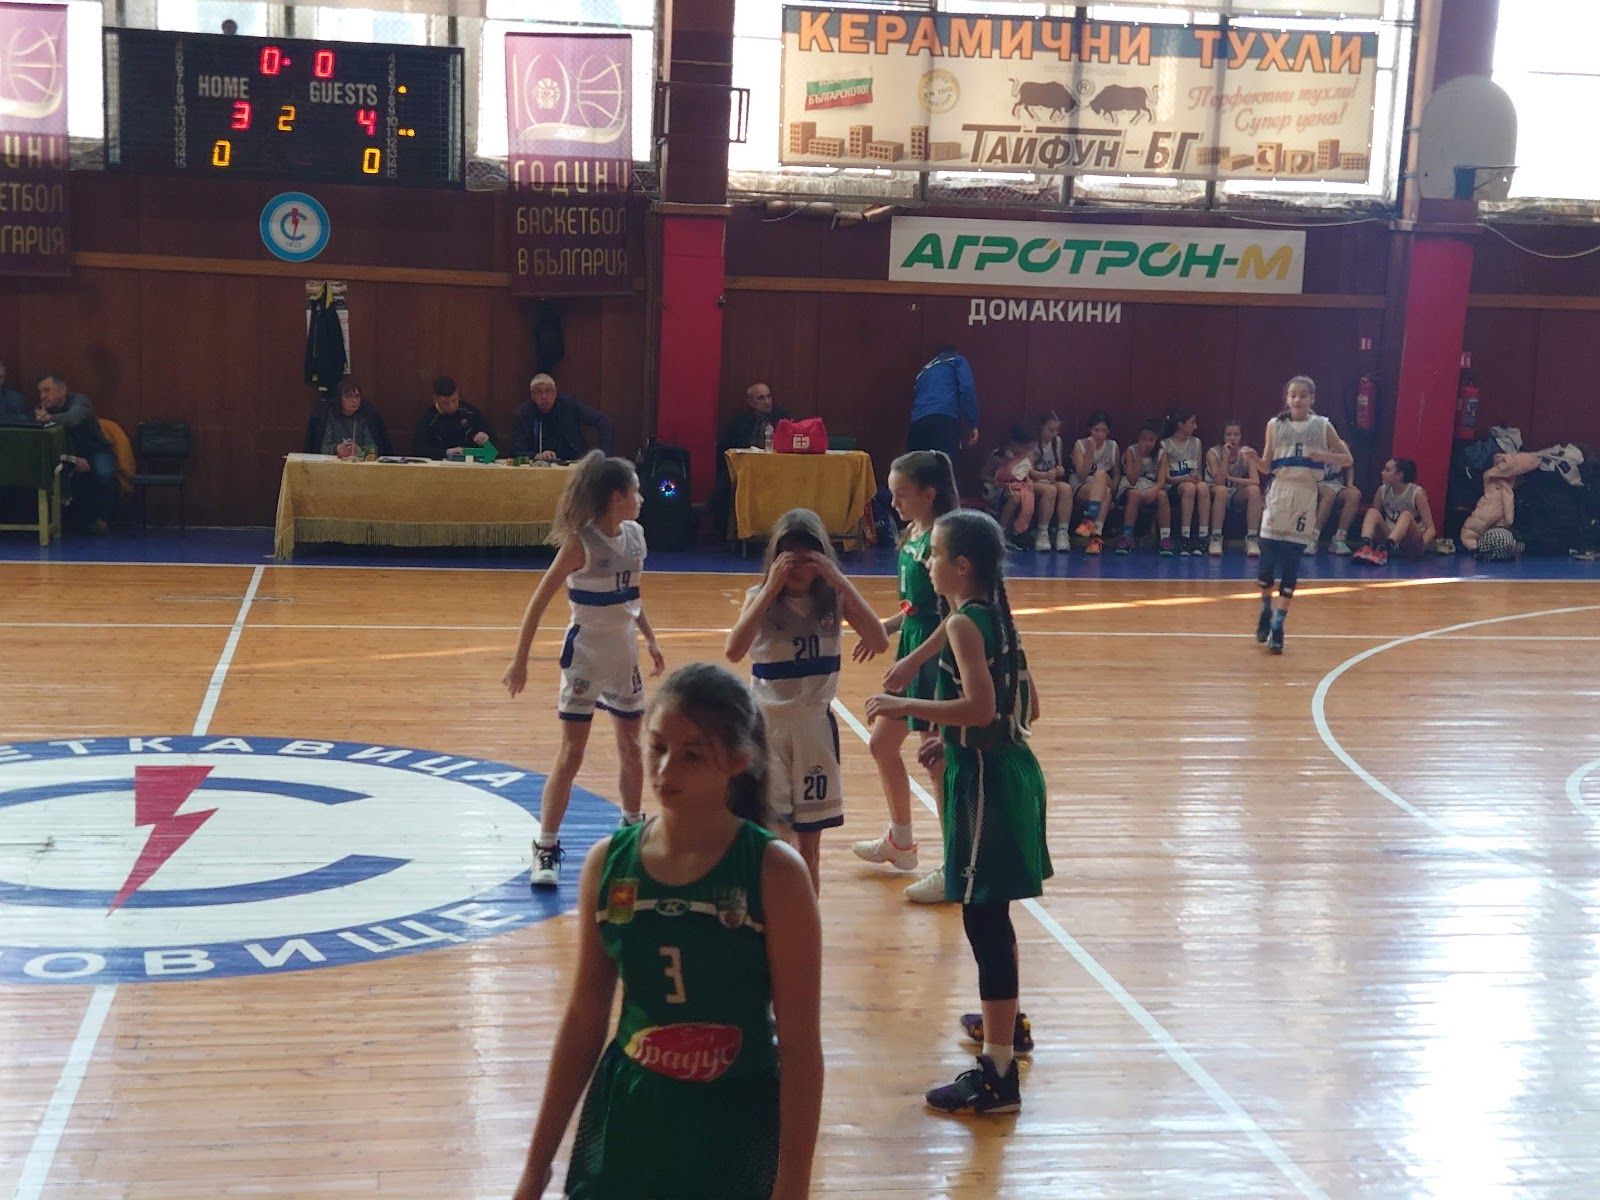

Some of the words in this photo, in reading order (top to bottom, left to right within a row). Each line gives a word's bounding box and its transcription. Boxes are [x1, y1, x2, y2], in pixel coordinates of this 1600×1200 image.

[799, 10, 1151, 65] КЕРАМИЧНИ
[1194, 29, 1362, 75] ТУХЛИ
[198, 74, 250, 99] HOME
[309, 81, 378, 106] GUESTS
[231, 101, 251, 130] 3
[277, 105, 296, 131] 2
[356, 108, 377, 135] 4
[212, 139, 231, 166] 0
[362, 148, 381, 174] 0
[514, 159, 629, 197] ГОДИНИ
[517, 207, 627, 235] БАСКЕТБОЛ
[518, 248, 528, 276] В
[534, 248, 628, 276] БЪЛГАРИЯ
[900, 232, 1293, 281] АГРОТРОН-М
[969, 299, 1122, 325] ДОМАКИНИ
[792, 634, 820, 663] 20
[803, 774, 828, 800] 20
[659, 946, 688, 1003] 3
